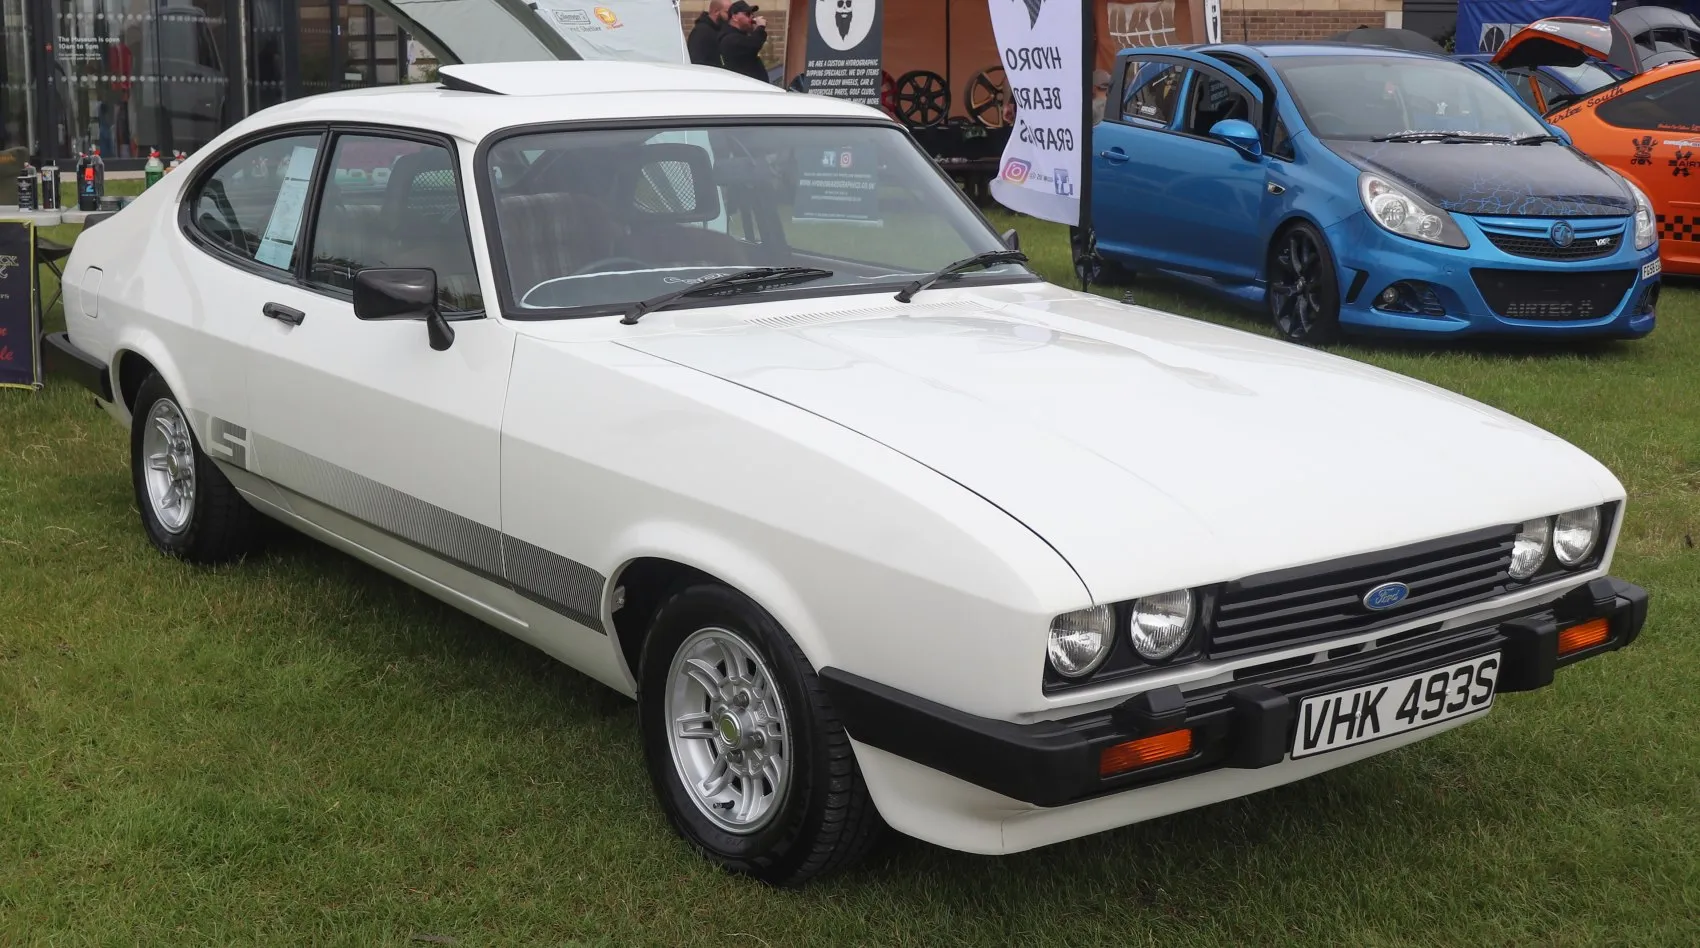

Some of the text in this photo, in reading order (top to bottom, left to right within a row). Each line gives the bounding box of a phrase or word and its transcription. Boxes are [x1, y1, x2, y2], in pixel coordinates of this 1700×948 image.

[827, 59, 845, 67] CUSTOM
[806, 69, 823, 77] DIPPING
[1586, 86, 1624, 108] South
[1595, 237, 1611, 246] VXR
[1506, 303, 1573, 316] AIRTEC
[1374, 588, 1401, 604] Ford
[1303, 659, 1497, 750] VHK 493S
